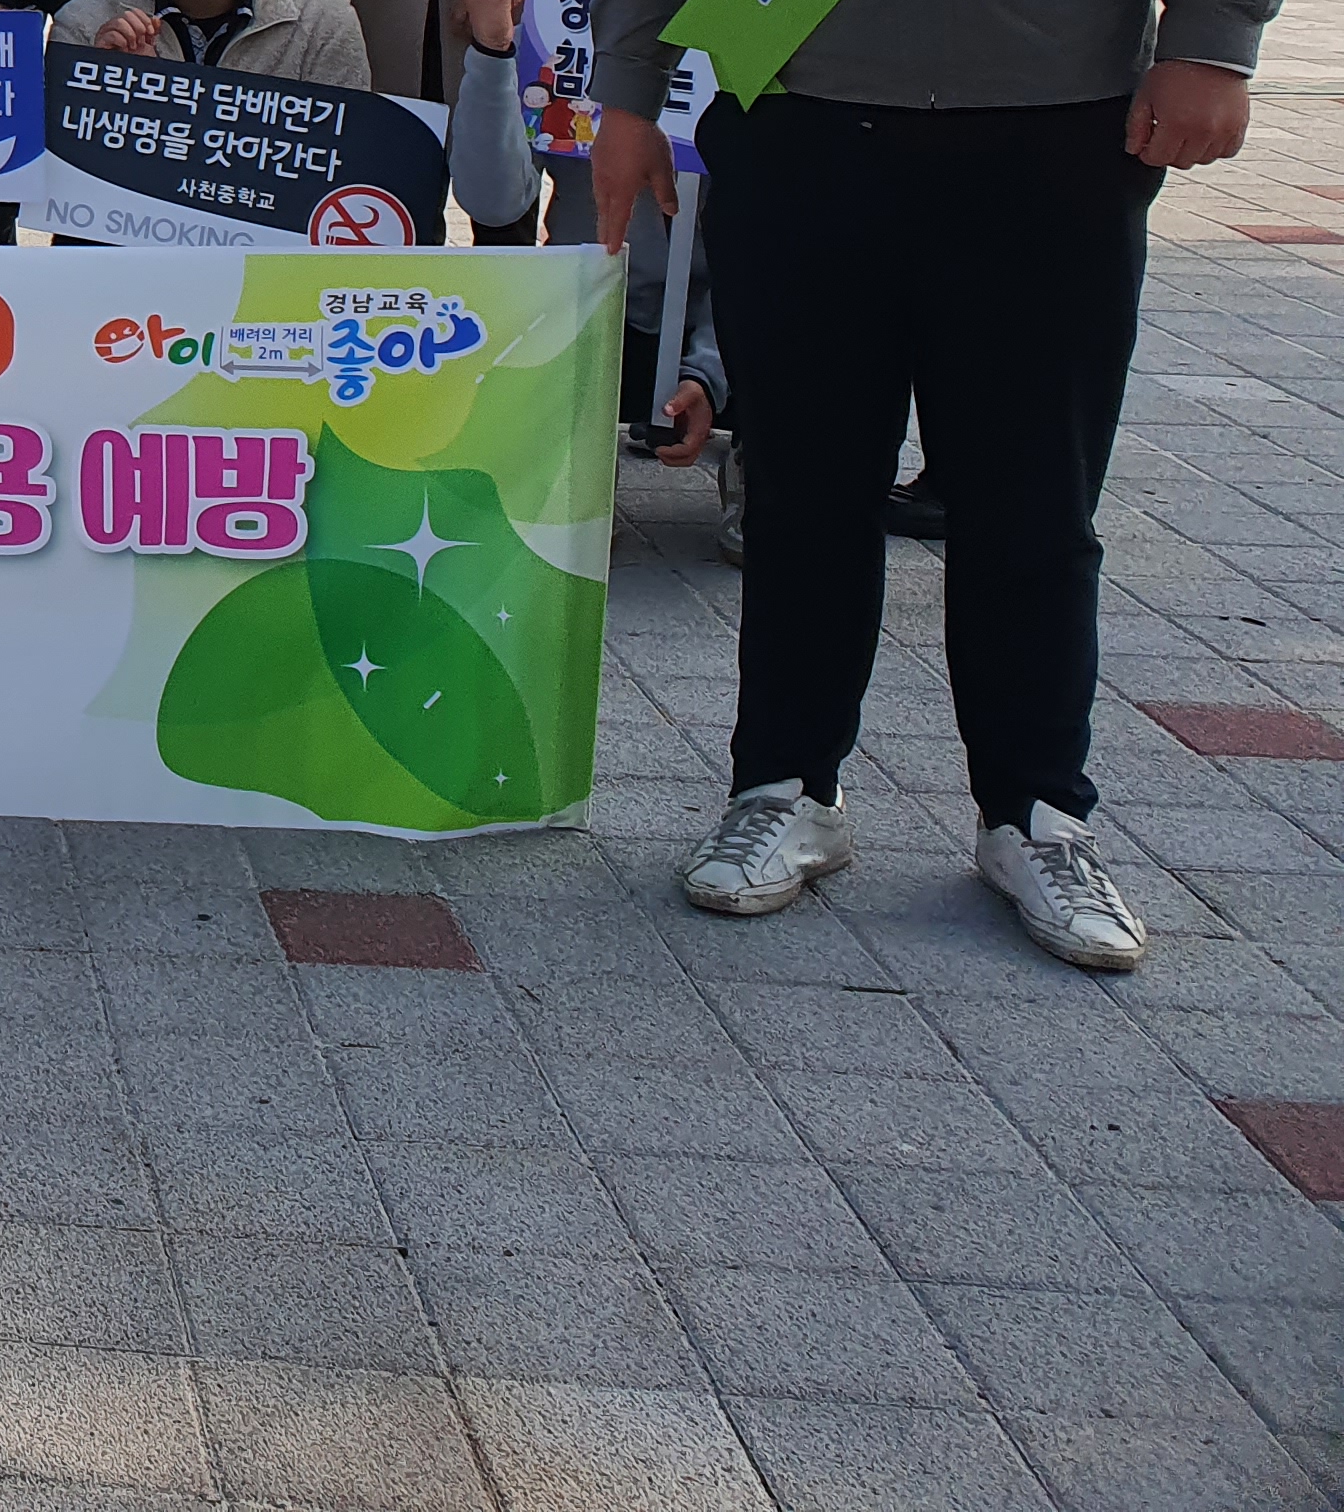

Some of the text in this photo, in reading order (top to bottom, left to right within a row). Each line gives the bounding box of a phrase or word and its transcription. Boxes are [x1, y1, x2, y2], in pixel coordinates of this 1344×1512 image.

[66, 62, 346, 137] 모락모락 담배연기
[62, 108, 342, 183] 내생명을 앗아간다
[176, 178, 276, 211] 사천중학교
[46, 198, 95, 228] NO
[325, 292, 430, 315] 경남교육
[229, 325, 314, 344] 배려의 거리
[93, 310, 481, 402] 아이 좋아
[258, 346, 283, 361] 2m
[80, 429, 307, 550] 예방
